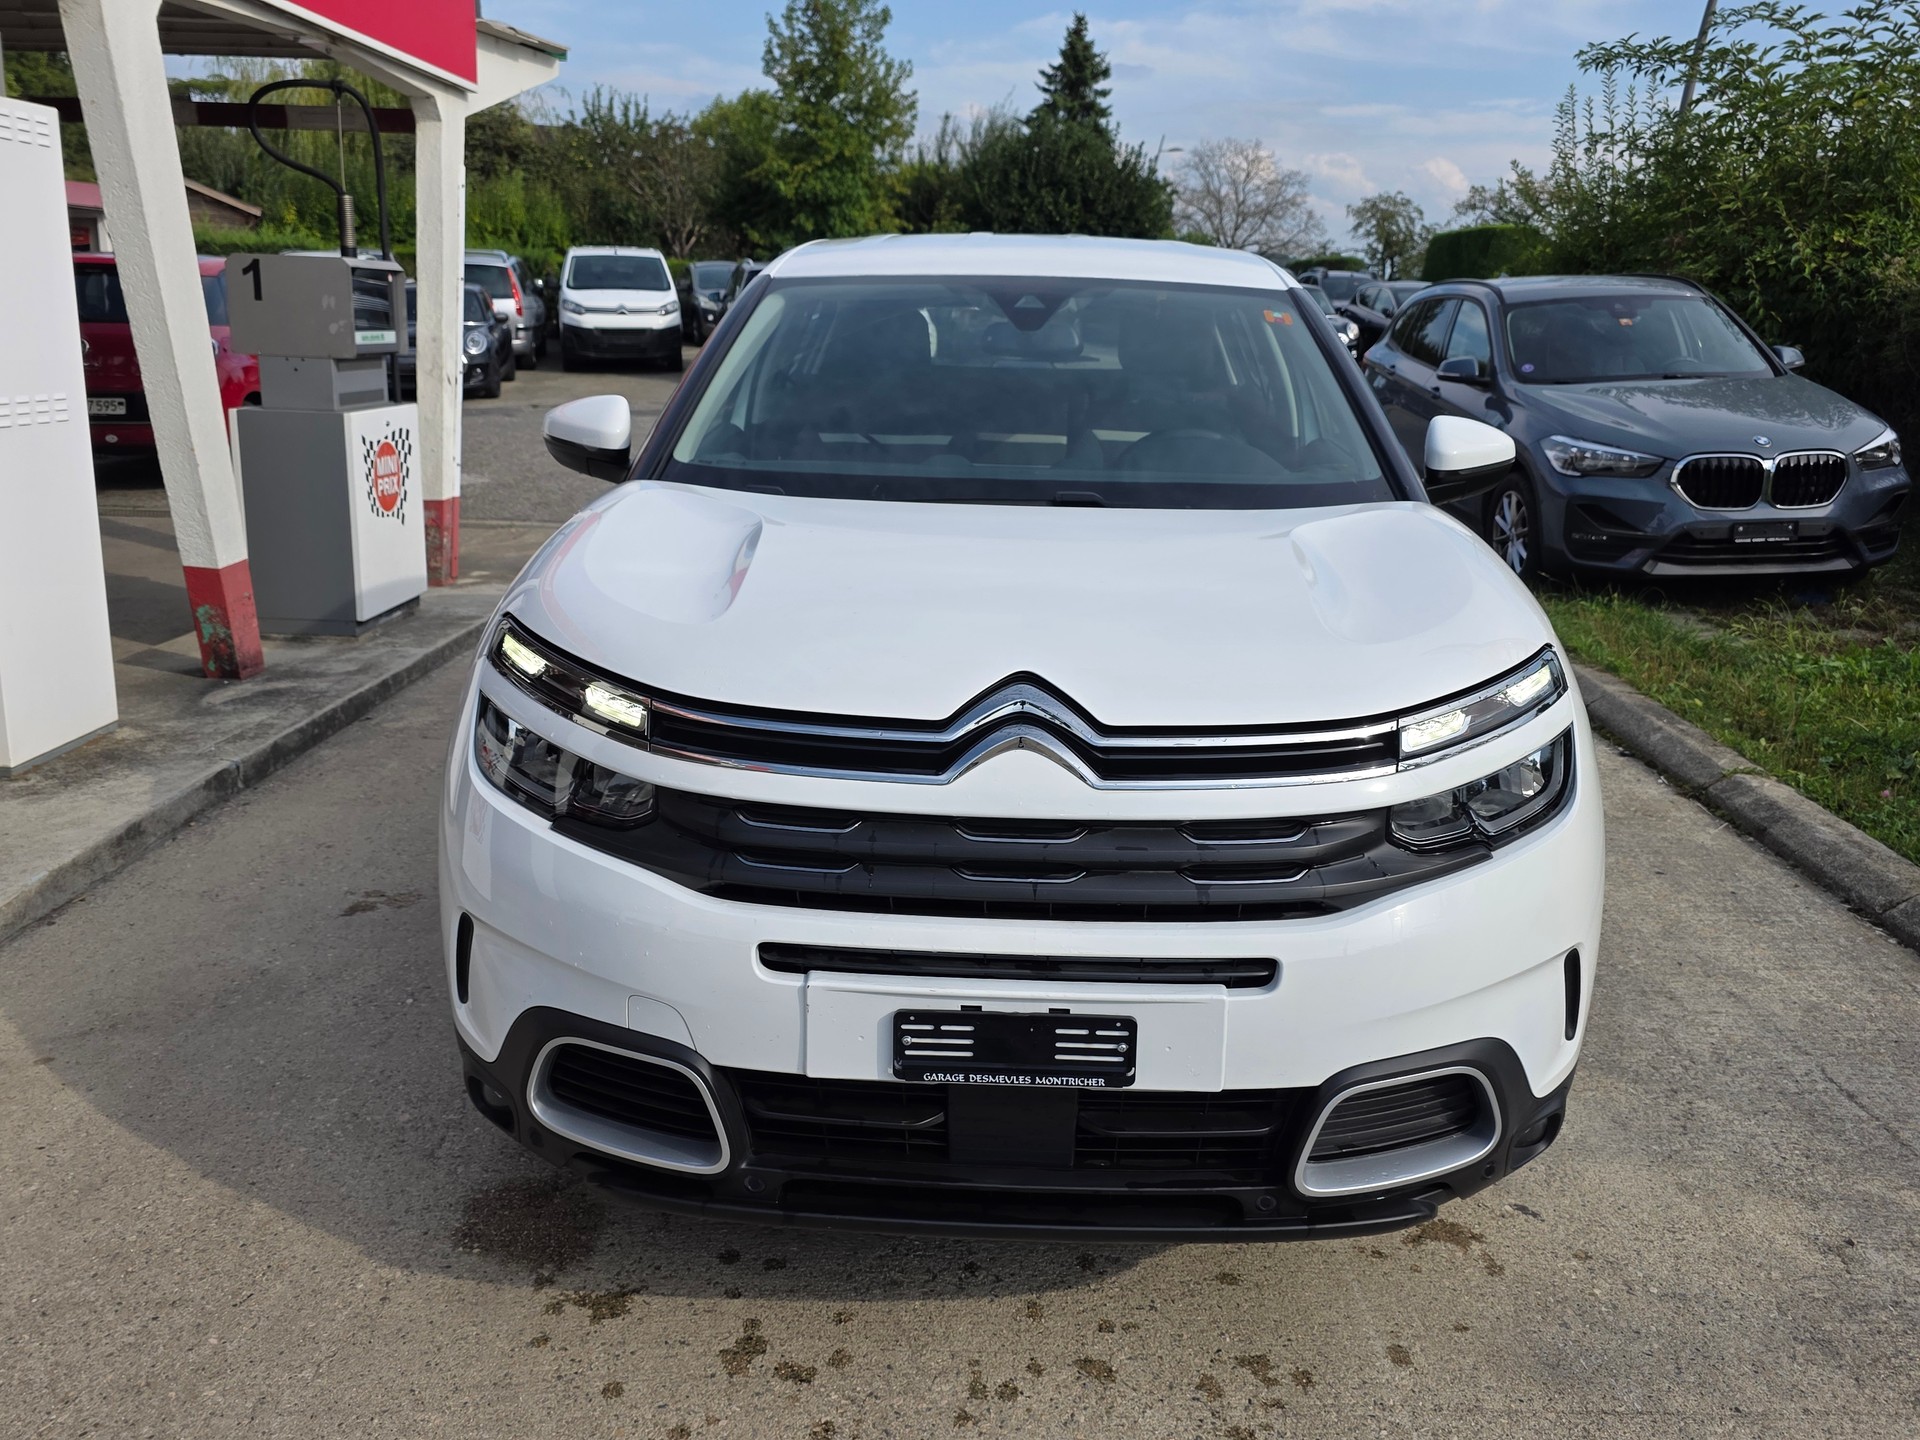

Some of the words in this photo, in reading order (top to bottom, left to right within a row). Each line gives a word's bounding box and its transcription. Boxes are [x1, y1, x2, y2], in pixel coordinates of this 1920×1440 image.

[242, 258, 263, 301] 1
[376, 455, 399, 477] MINI
[377, 475, 400, 497] PRIX
[923, 1072, 965, 1082] GARAGE
[1035, 1076, 1106, 1087] MONTRICHER
